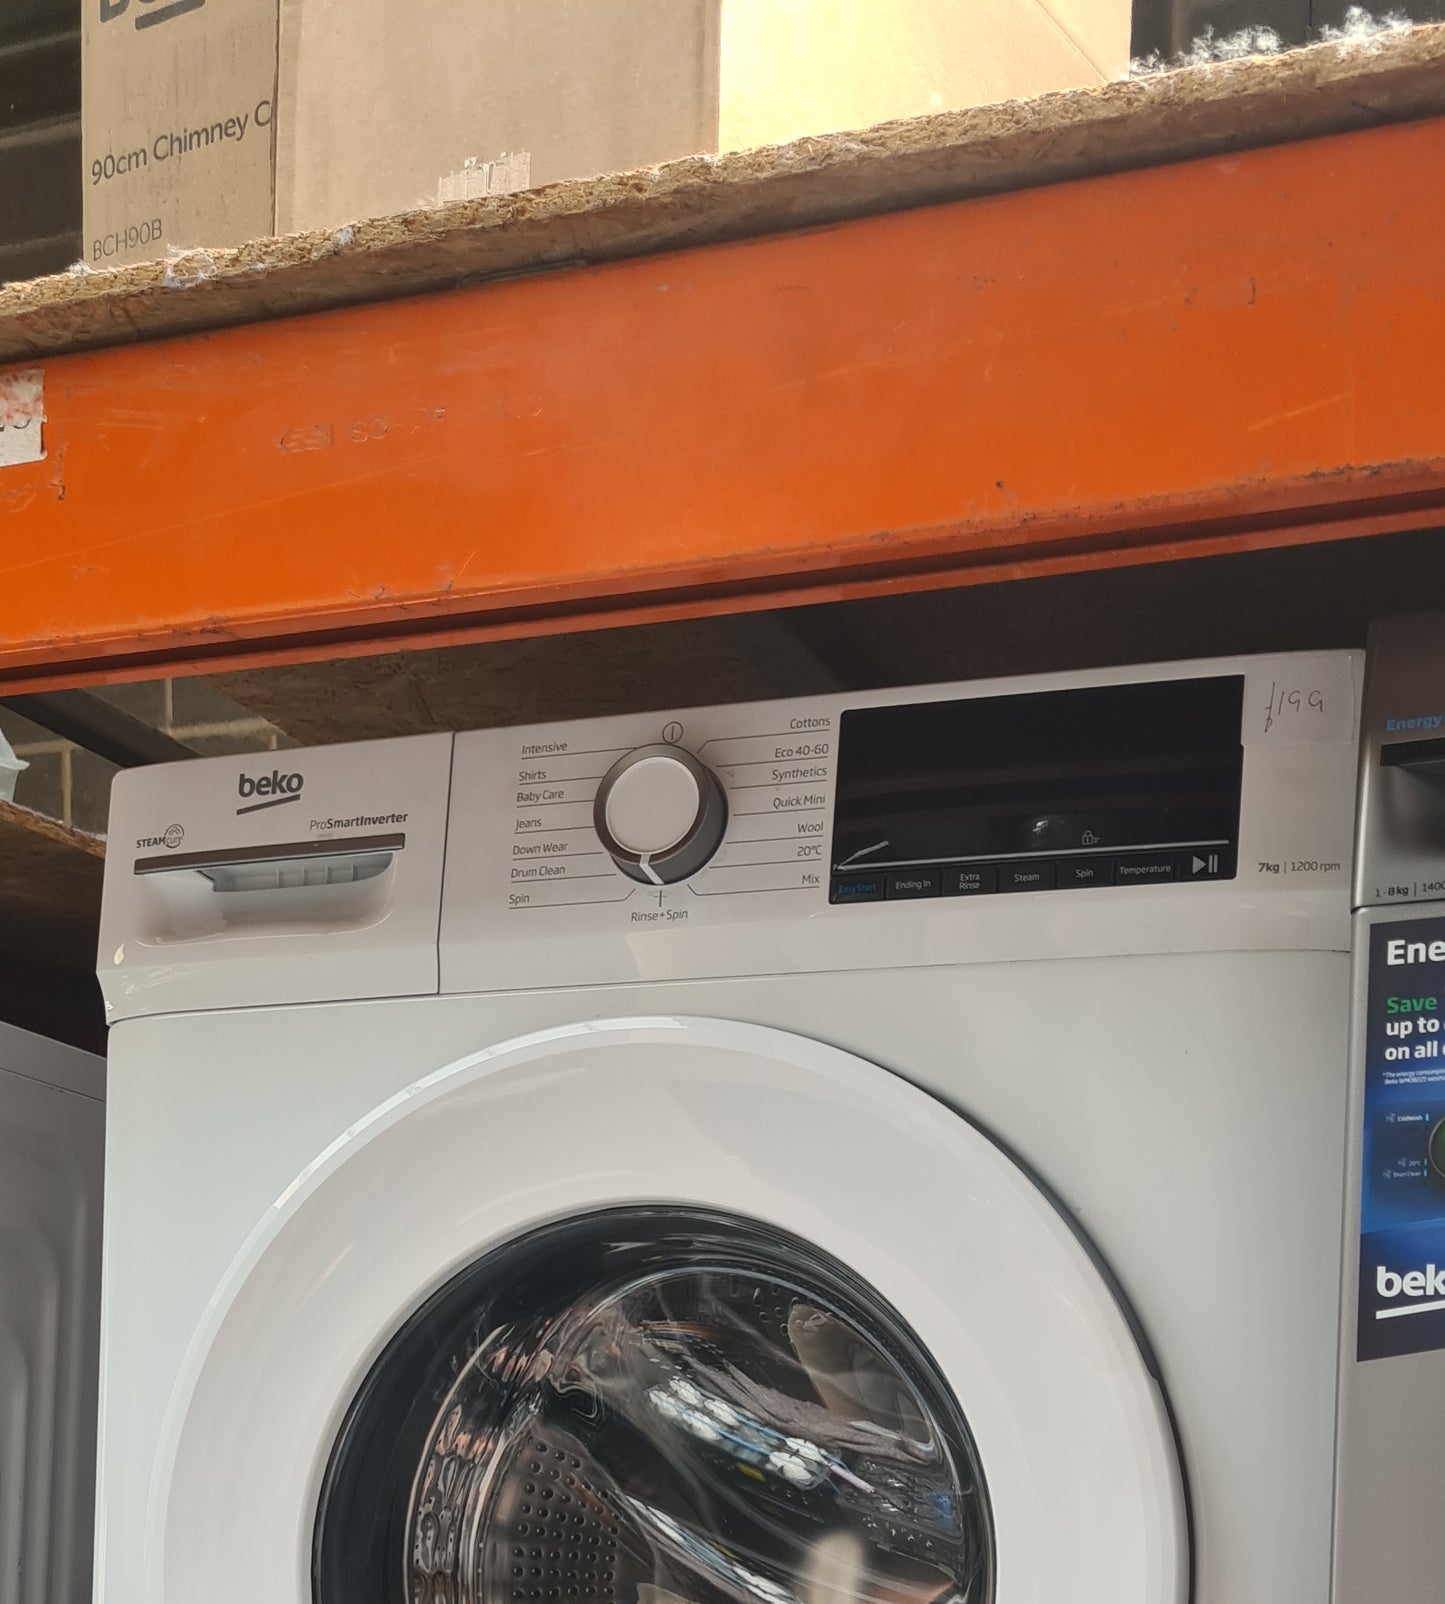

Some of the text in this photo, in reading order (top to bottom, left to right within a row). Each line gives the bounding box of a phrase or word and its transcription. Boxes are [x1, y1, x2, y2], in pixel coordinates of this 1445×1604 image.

[92, 148, 147, 186] 90cm
[153, 113, 249, 161] Chimney
[93, 218, 163, 262] BCH90B
[790, 717, 831, 729] Cottons
[1386, 714, 1445, 731] Energy
[521, 741, 568, 755] Intensive
[775, 744, 829, 758] Eco 40-60
[519, 770, 547, 782] Shirts
[772, 767, 828, 780] Synthetics
[238, 770, 304, 798] beko
[517, 789, 564, 803] Baby Care
[773, 794, 826, 809] Quick Mini
[309, 812, 409, 831] ProSmartInverter
[515, 817, 542, 830] Jeans
[797, 822, 824, 833] Wool
[513, 842, 568, 856] Down Wear
[511, 865, 566, 879] Drum Clean
[1075, 869, 1094, 879] Spin
[1119, 865, 1172, 876] Temperature
[1258, 861, 1340, 874] 7kg 1200 rpm
[802, 874, 820, 885] Mix
[960, 874, 981, 882] Extra
[1014, 873, 1040, 883] Steam
[895, 880, 932, 891] Ending In
[959, 882, 980, 890] Rinse
[509, 894, 530, 905] Spin
[1387, 996, 1437, 1014] Save
[1386, 1017, 1440, 1039] up to
[1385, 1040, 1438, 1061] on all
[1376, 1264, 1445, 1298] bek
